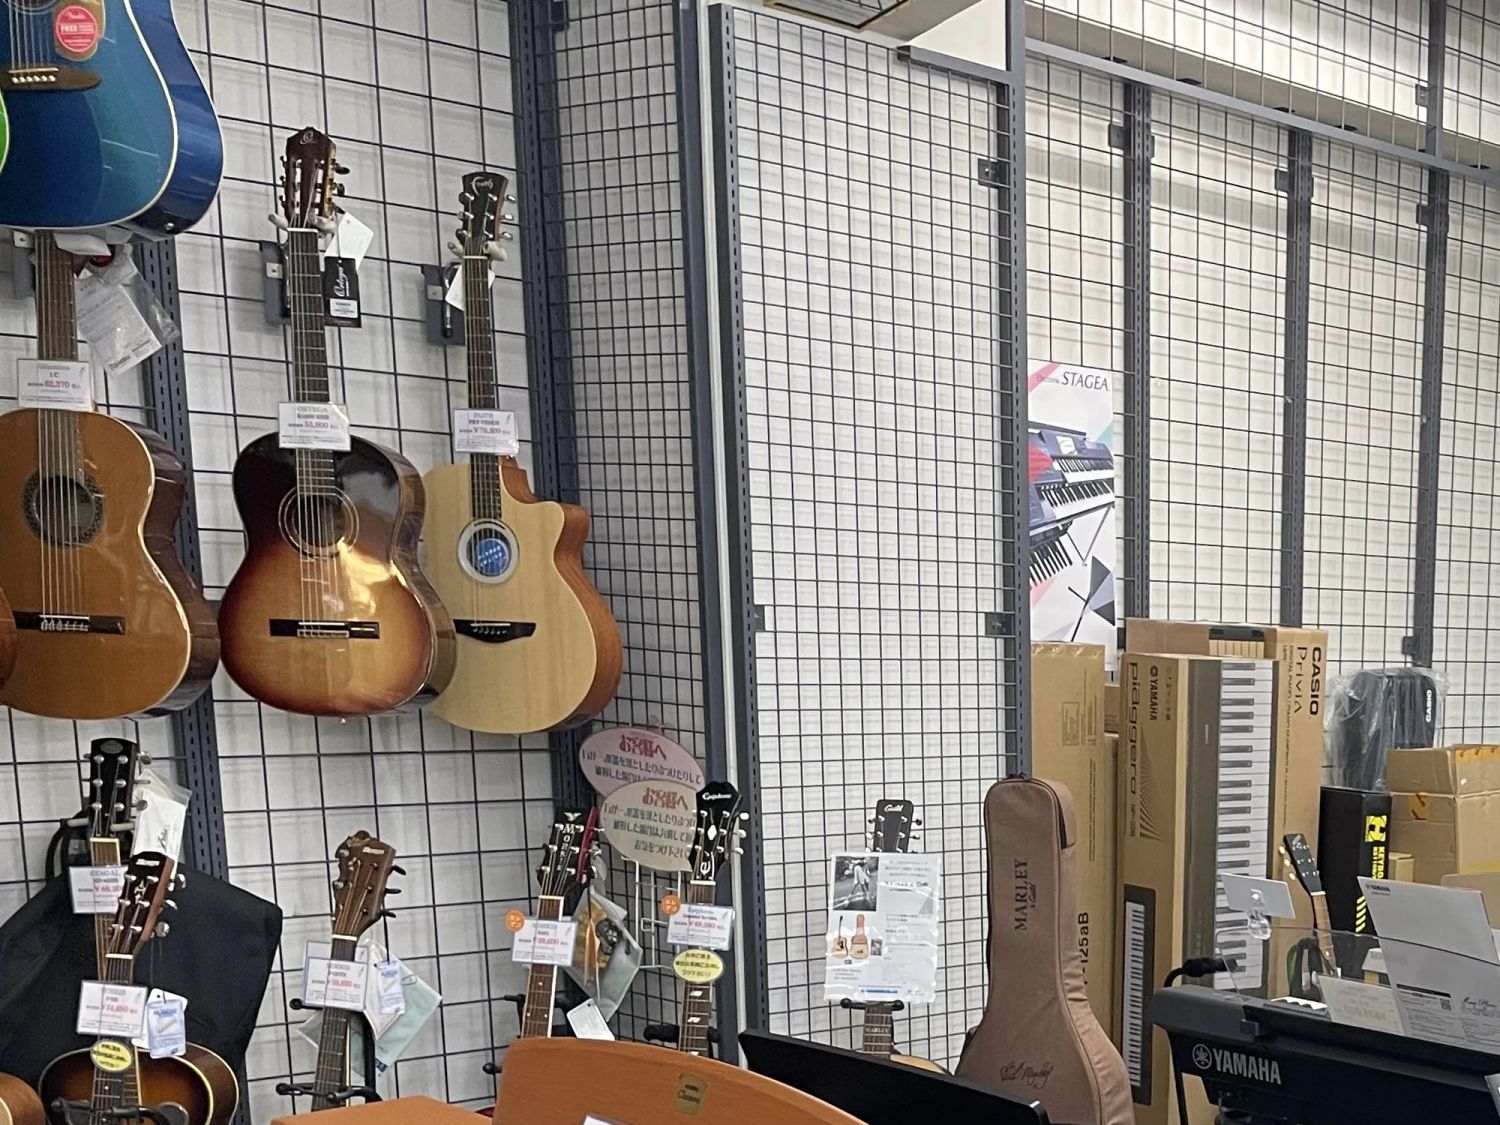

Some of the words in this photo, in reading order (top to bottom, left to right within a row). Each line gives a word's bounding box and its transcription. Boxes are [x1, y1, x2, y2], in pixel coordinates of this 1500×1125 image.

[1062, 371, 1109, 391] STAGEA
[1149, 679, 1159, 721] YAMAHA
[1309, 647, 1322, 716] CASIO
[1425, 689, 1433, 723] CASIO
[1014, 858, 1029, 931] MARLEY
[1078, 911, 1090, 985] -125aB
[1213, 1050, 1282, 1085] YAMAHA
